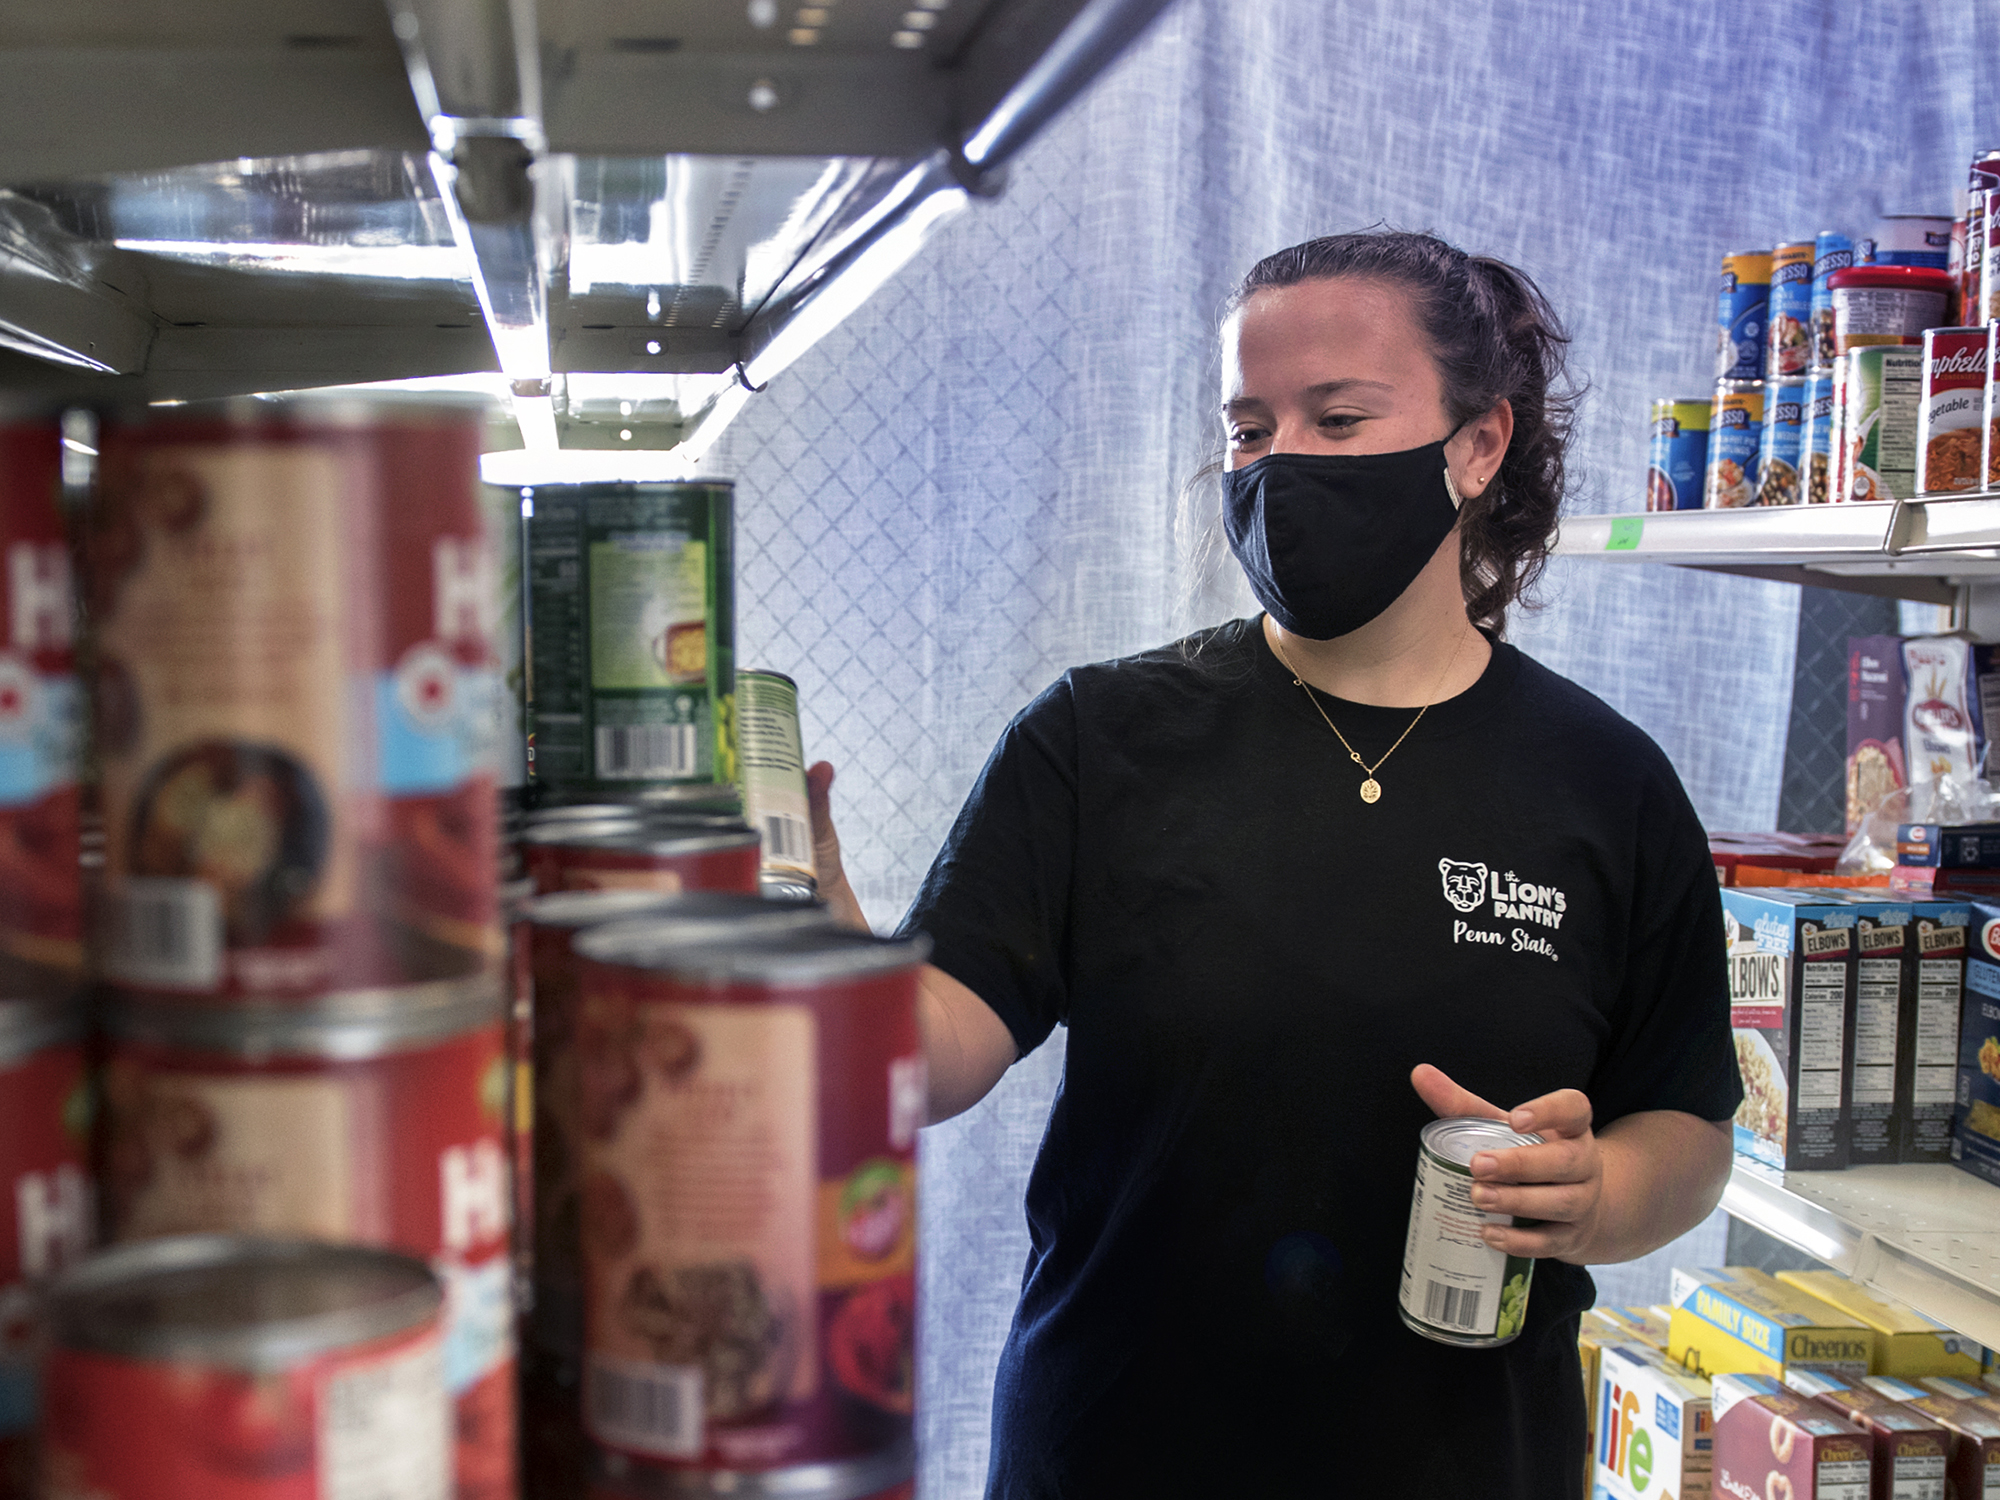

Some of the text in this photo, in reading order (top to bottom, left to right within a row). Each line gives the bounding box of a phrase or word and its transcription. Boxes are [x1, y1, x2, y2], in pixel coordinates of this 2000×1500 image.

[1928, 397, 1970, 424] egetable
[1504, 870, 1520, 882] the
[1494, 901, 1563, 929] PANTRY
[1754, 912, 1790, 939] gluten
[1453, 919, 1505, 945] Penn
[1808, 932, 1846, 952] ELBOWS
[1862, 930, 1901, 949] ELBOWS
[1923, 930, 1962, 950] ELBOWS
[1696, 1289, 1771, 1352] FAMILY SIZE
[1599, 1379, 1653, 1493] life
